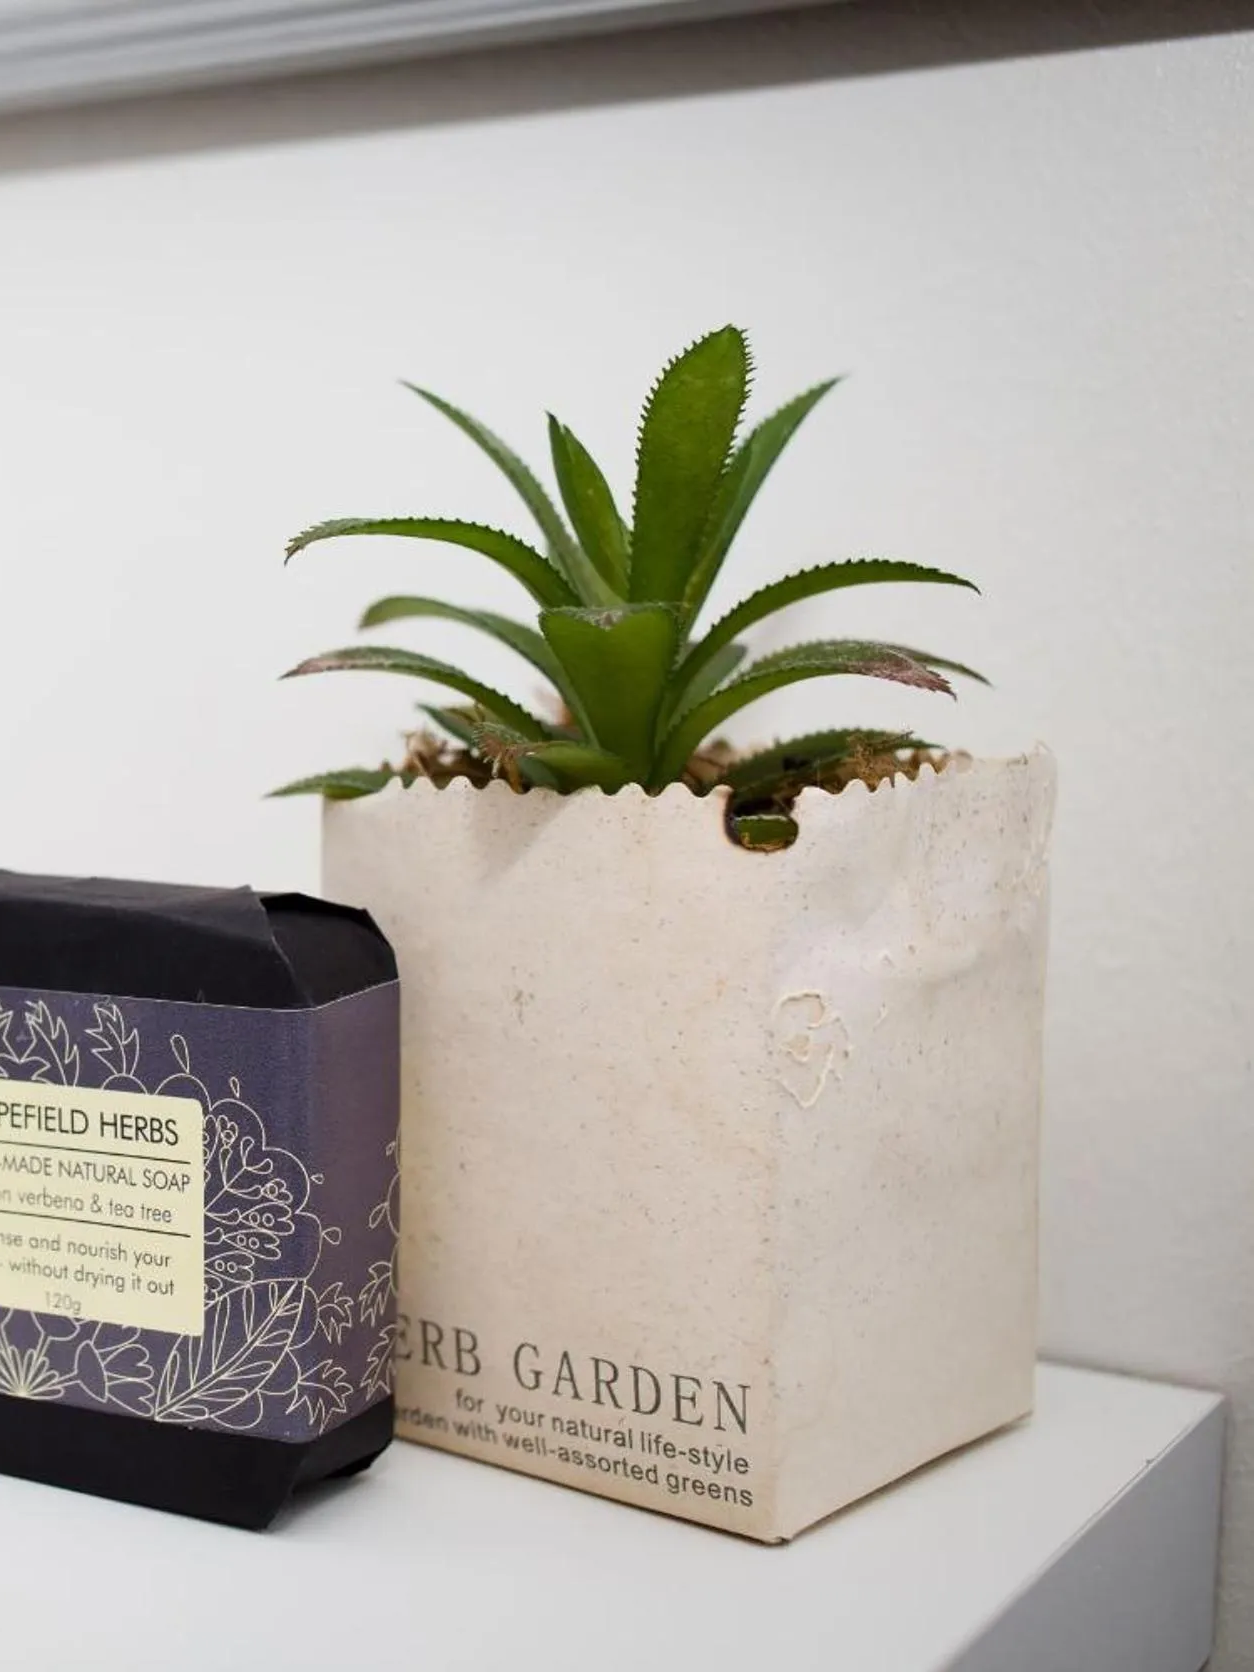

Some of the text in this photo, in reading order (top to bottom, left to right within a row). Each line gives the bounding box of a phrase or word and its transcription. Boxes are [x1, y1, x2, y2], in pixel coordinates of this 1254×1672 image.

[99, 1112, 179, 1146] HERBS
[58, 1160, 137, 1187] NATURAL
[142, 1169, 191, 1194] SOAP
[17, 1187, 84, 1211] verbena
[90, 1193, 103, 1214] &
[109, 1199, 134, 1218] tea
[140, 1200, 172, 1223] tree
[28, 1233, 61, 1252] and
[67, 1240, 128, 1262] nourish
[133, 1250, 172, 1270] your
[9, 1257, 69, 1280] without
[73, 1268, 125, 1293] drying
[131, 1273, 142, 1291] it
[147, 1279, 175, 1296] out
[45, 1291, 82, 1315] 120g
[513, 1342, 751, 1434] GARDEN
[455, 1388, 749, 1475] for your natural life-style
[395, 1404, 753, 1508] rden with well-assorted greens
